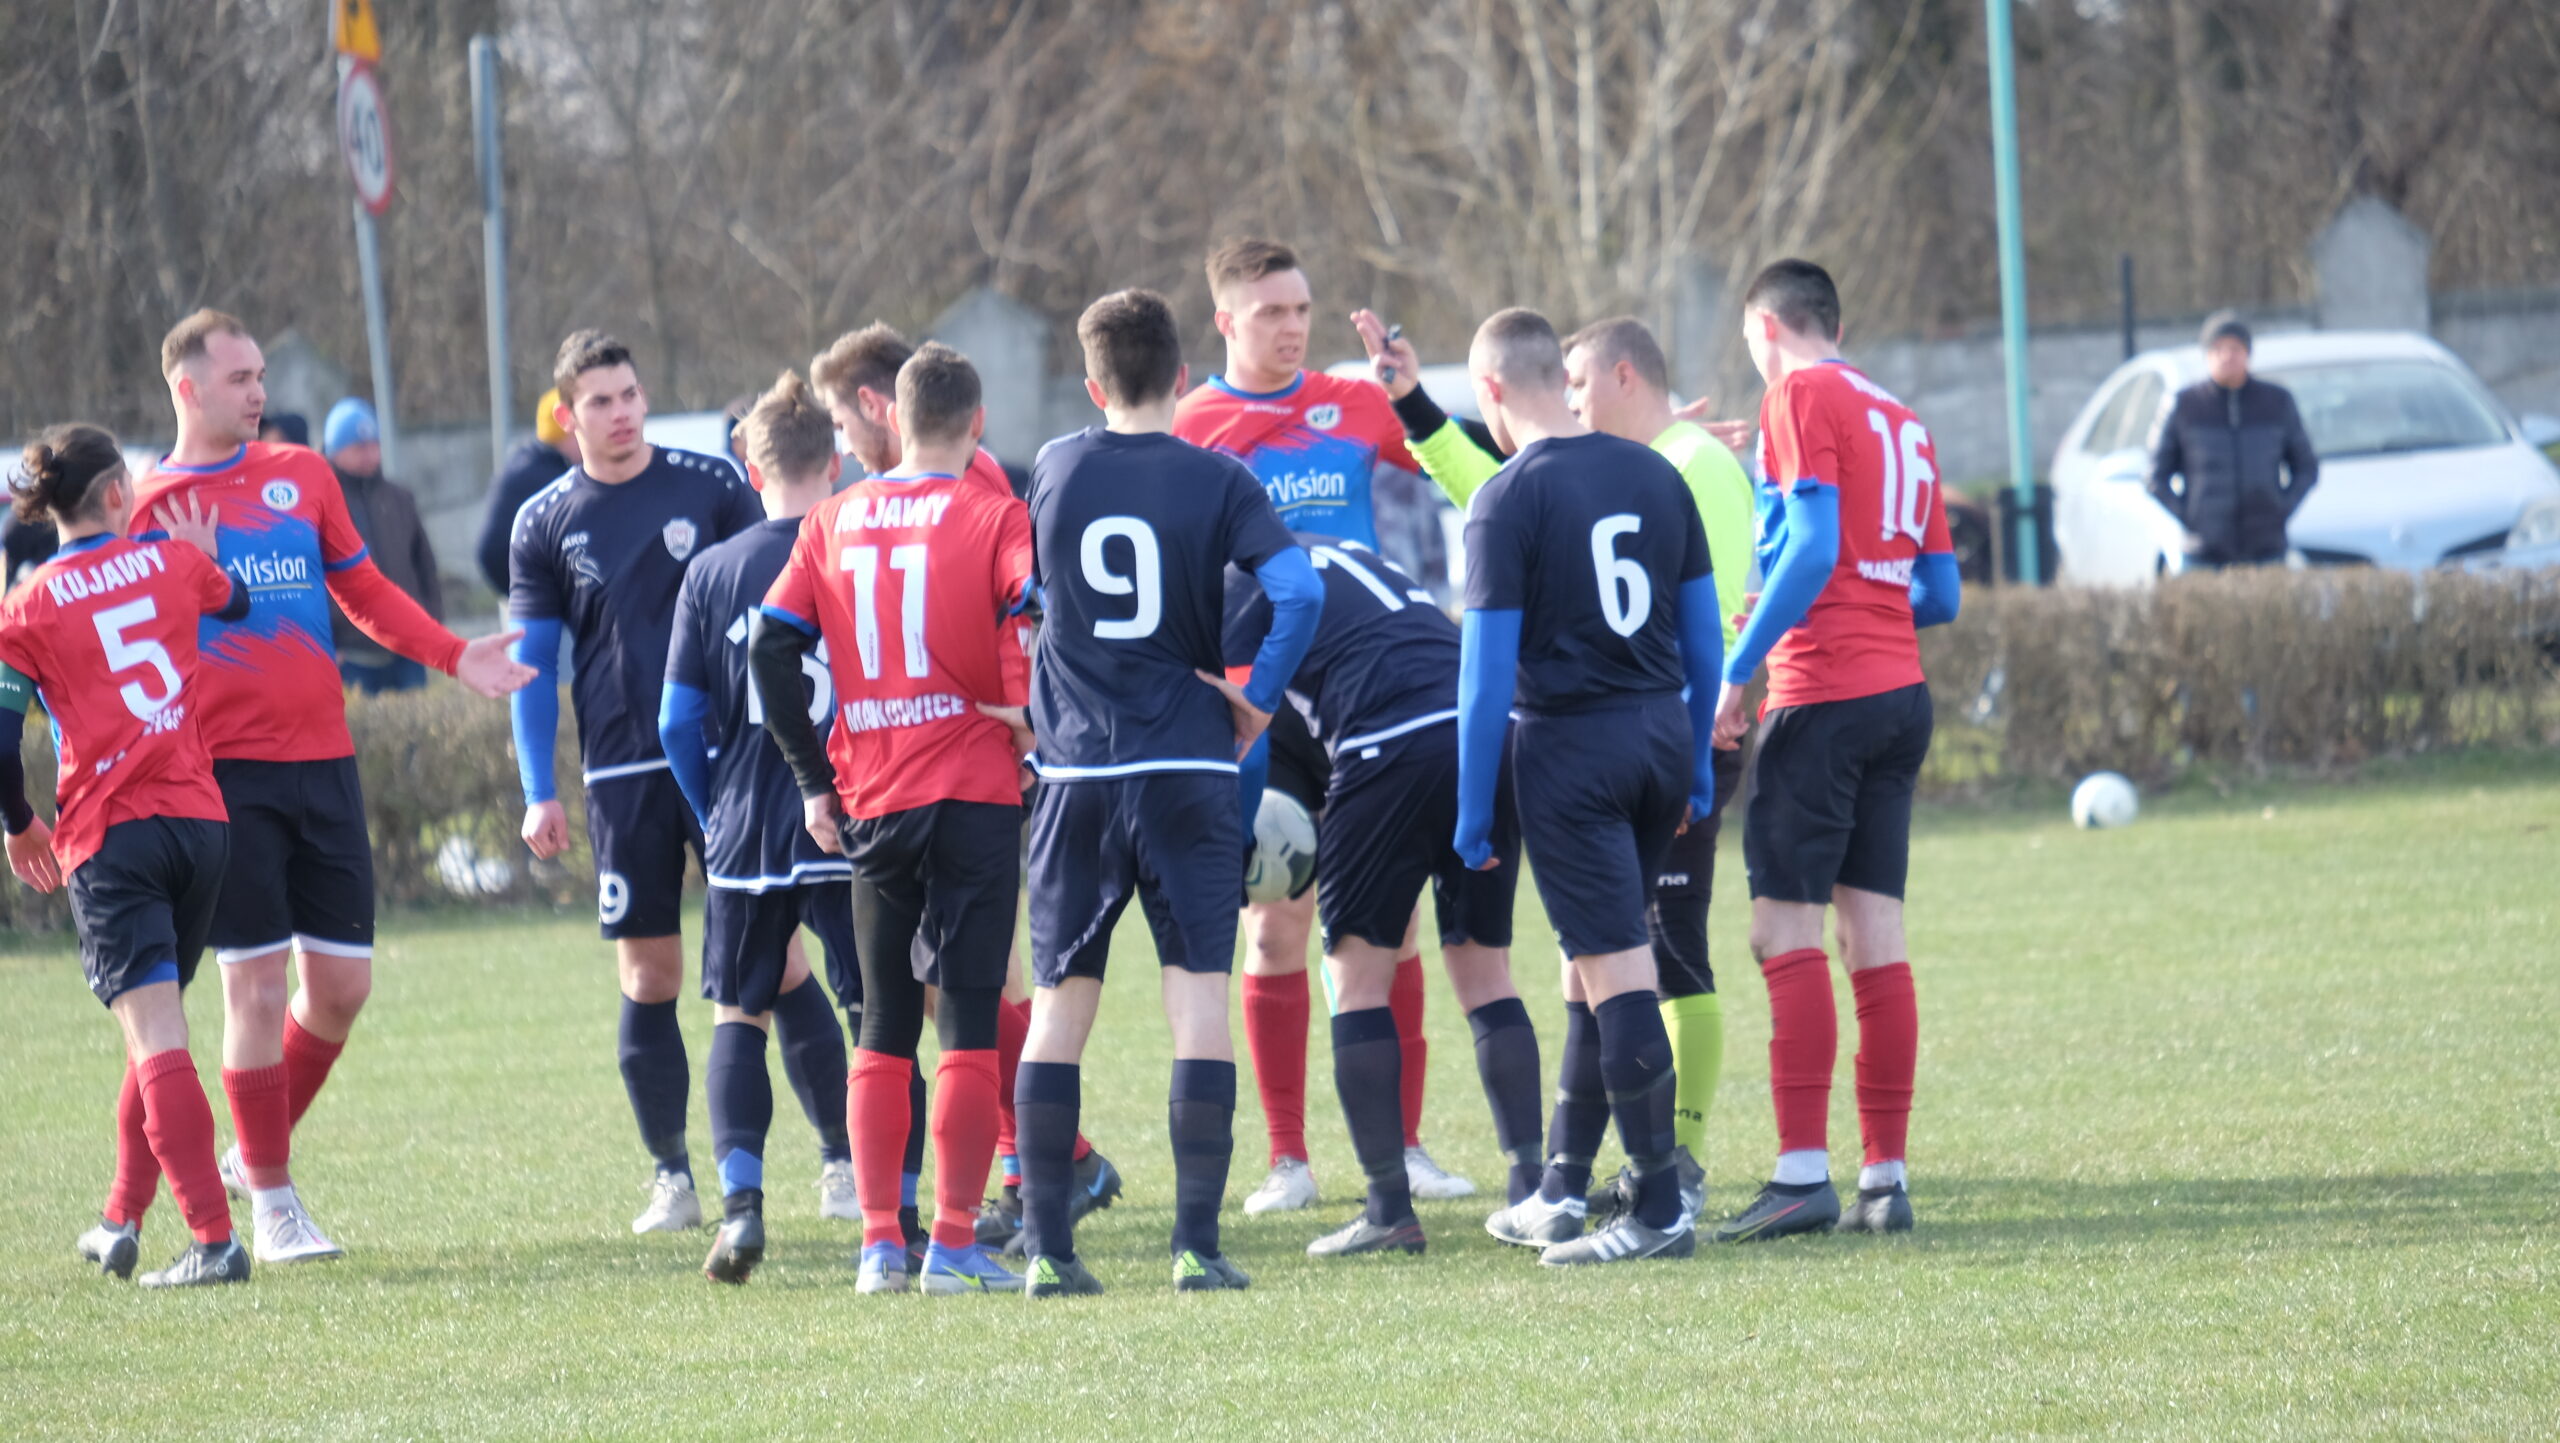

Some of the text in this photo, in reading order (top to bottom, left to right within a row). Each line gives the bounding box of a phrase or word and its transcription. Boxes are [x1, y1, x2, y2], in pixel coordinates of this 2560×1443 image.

[1867, 409, 1935, 548] 16
[47, 546, 165, 607] KUJAWY
[840, 544, 928, 679] 11
[1080, 516, 1162, 639] 9
[1591, 513, 1651, 637] 6
[92, 596, 182, 722] 5
